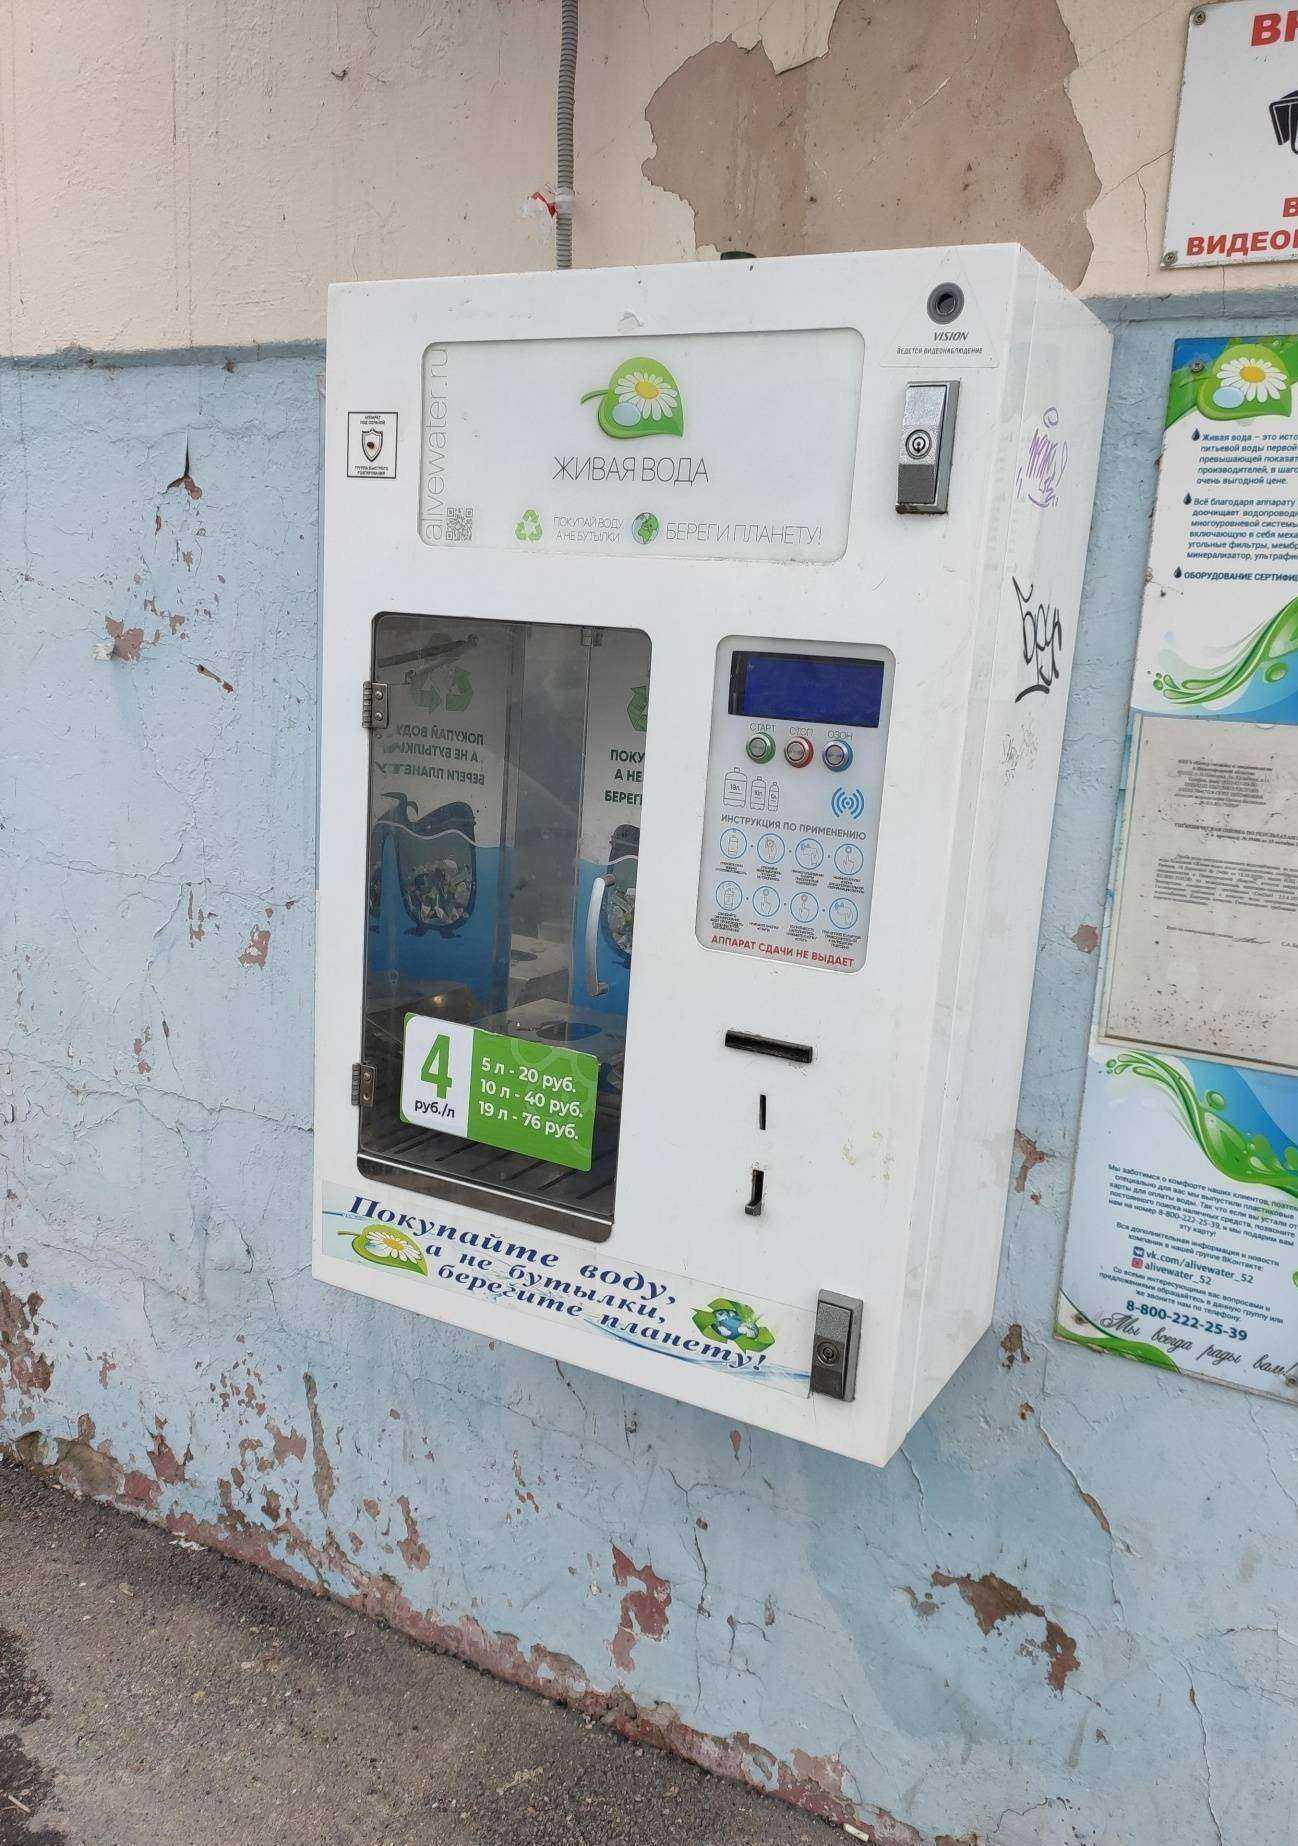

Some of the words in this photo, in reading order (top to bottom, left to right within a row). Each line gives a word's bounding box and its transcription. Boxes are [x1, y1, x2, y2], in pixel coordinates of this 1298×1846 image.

[1187, 229, 1298, 257] ВИДЕО
[934, 331, 969, 341] VISION
[924, 347, 983, 355] ВИДЕОНАБЛЮДЕНИЕ
[421, 348, 448, 540] alivewater.ru
[1200, 444, 1239, 452] питьевой
[1242, 445, 1264, 453] воды
[1266, 444, 1297, 453] первой
[1202, 433, 1229, 441] Живая
[1231, 434, 1252, 442] вода
[1199, 455, 1262, 464] превышающей
[552, 456, 636, 481] ЖИВАЯ
[641, 457, 709, 487] ВОДА
[1222, 476, 1264, 485] выгодной
[1210, 498, 1254, 507] благодаря
[1256, 499, 1295, 507] аппарату
[553, 516, 597, 528] ПОКУПАЙ
[598, 517, 623, 529] ВОДУ
[666, 522, 730, 542] БЕРЕГИ
[734, 524, 824, 545] ПЛАНЕТУ!
[1191, 520, 1260, 528] многоуровневой
[564, 530, 576, 541] НЕ
[577, 530, 620, 542] БУТЫЛКИ
[1189, 531, 1246, 539] включающую
[1184, 571, 1253, 581] ОБОРУДОВАНИЕ
[749, 722, 776, 733] СТАРТ
[789, 726, 814, 737] СТОП
[827, 730, 853, 741] ОЗОН
[610, 749, 645, 763] ПОКУ
[615, 768, 623, 781] А
[626, 770, 642, 782] НЕ
[721, 814, 781, 831] ИНСТРУКЦИЯ
[783, 822, 797, 831] ПО
[800, 823, 867, 840] ПРИМЕНЕНИЮ
[711, 935, 756, 950] АППАРАТ
[758, 942, 794, 957] СДАЧИ
[796, 947, 809, 960] НЕ
[811, 952, 854, 968] ВЫДАЕТ
[420, 1034, 453, 1100] 4
[481, 1057, 491, 1072] 5
[494, 1063, 505, 1075] л
[518, 1066, 538, 1083] 20
[542, 1073, 576, 1093] руб.
[414, 1099, 455, 1119] руб./л
[480, 1078, 496, 1095] 10
[500, 1087, 510, 1099] л
[524, 1091, 545, 1107] 40
[549, 1098, 583, 1118] руб.
[479, 1100, 494, 1116] 19
[497, 1109, 508, 1121] л
[522, 1112, 541, 1129] 76
[545, 1121, 578, 1140] руб.
[1108, 1164, 1120, 1172] Мы
[1168, 1178, 1206, 1191] комфорте
[1207, 1186, 1230, 1196] наших
[1109, 1183, 1131, 1191] карты
[1148, 1191, 1174, 1200] оплаты
[1200, 1202, 1212, 1210] Так
[1229, 1209, 1246, 1218] если
[1261, 1217, 1287, 1227] устали
[1115, 1175, 1156, 1188] специально
[1201, 1194, 1242, 1207] выпустили
[1243, 1203, 1294, 1219] пластиковые
[1110, 1191, 1154, 1205] постоянного
[1156, 1201, 1181, 1211] поиска
[1255, 1224, 1295, 1238] позвоните
[1134, 1205, 1156, 1214] номер
[1243, 1230, 1277, 1242] подарим
[1279, 1238, 1294, 1246] вам
[1180, 1224, 1191, 1232] эту
[348, 1195, 560, 1268] Покупайте
[579, 1263, 676, 1305] воду,
[1116, 1222, 1130, 1230] Вся
[1248, 1255, 1280, 1267] новости
[1171, 1244, 1194, 1254] нашей
[1195, 1250, 1220, 1260] группе
[1145, 1262, 1212, 1286] alivewater_52
[1146, 1250, 1254, 1284] vk.com/alivewater_52
[425, 1244, 442, 1258] а
[460, 1252, 493, 1271] не
[508, 1263, 666, 1324] бутылки,
[1177, 1300, 1191, 1308] нам
[1208, 1291, 1220, 1299] вас
[1222, 1295, 1264, 1310] вопросами
[437, 1264, 583, 1317] берегите
[600, 1313, 767, 1371] планету!
[1126, 1300, 1248, 1341] 8-800-222-25-39
[1213, 1302, 1241, 1313] данную
[1243, 1309, 1268, 1321] группу
[1270, 1316, 1284, 1324] или
[1100, 1312, 1141, 1337] Мы
[1151, 1326, 1194, 1353] всегда
[1196, 1344, 1242, 1365] рады
